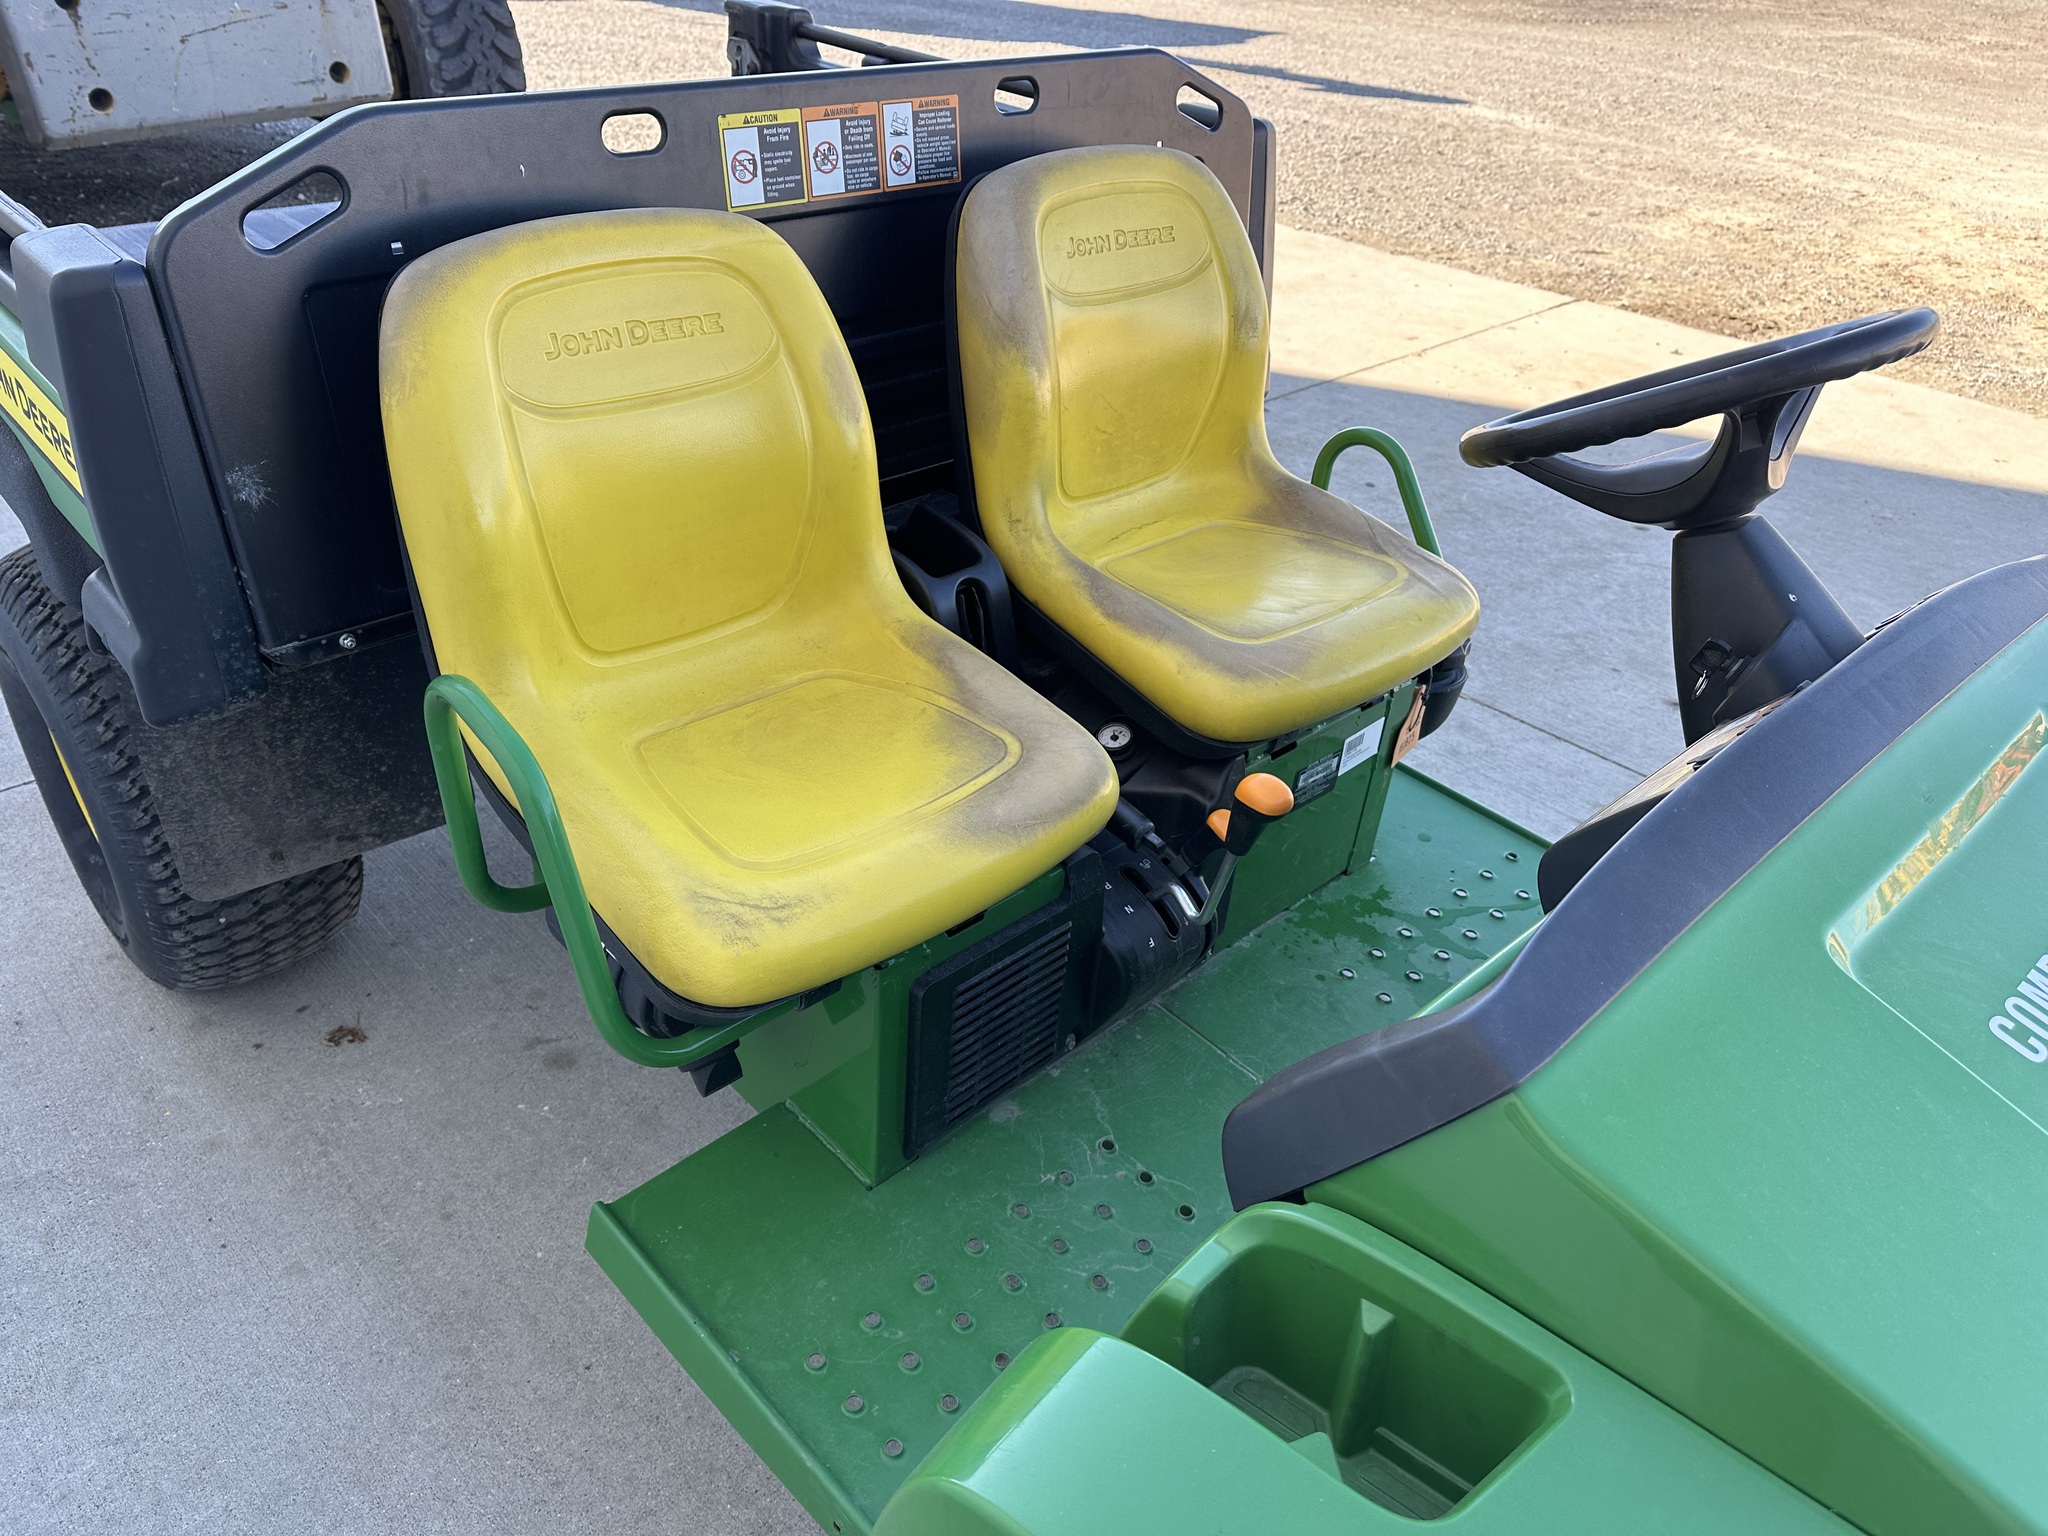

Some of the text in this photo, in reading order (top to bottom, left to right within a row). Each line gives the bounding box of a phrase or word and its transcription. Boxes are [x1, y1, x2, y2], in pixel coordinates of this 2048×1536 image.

[924, 98, 949, 107] WARNING
[830, 107, 858, 116] WARNING
[750, 114, 778, 124] CAUTION
[1066, 225, 1176, 259] JOHN DEERE
[544, 312, 724, 361] JOHN DEERE
[14, 376, 77, 472] DEERE
[1124, 904, 1134, 914] N
